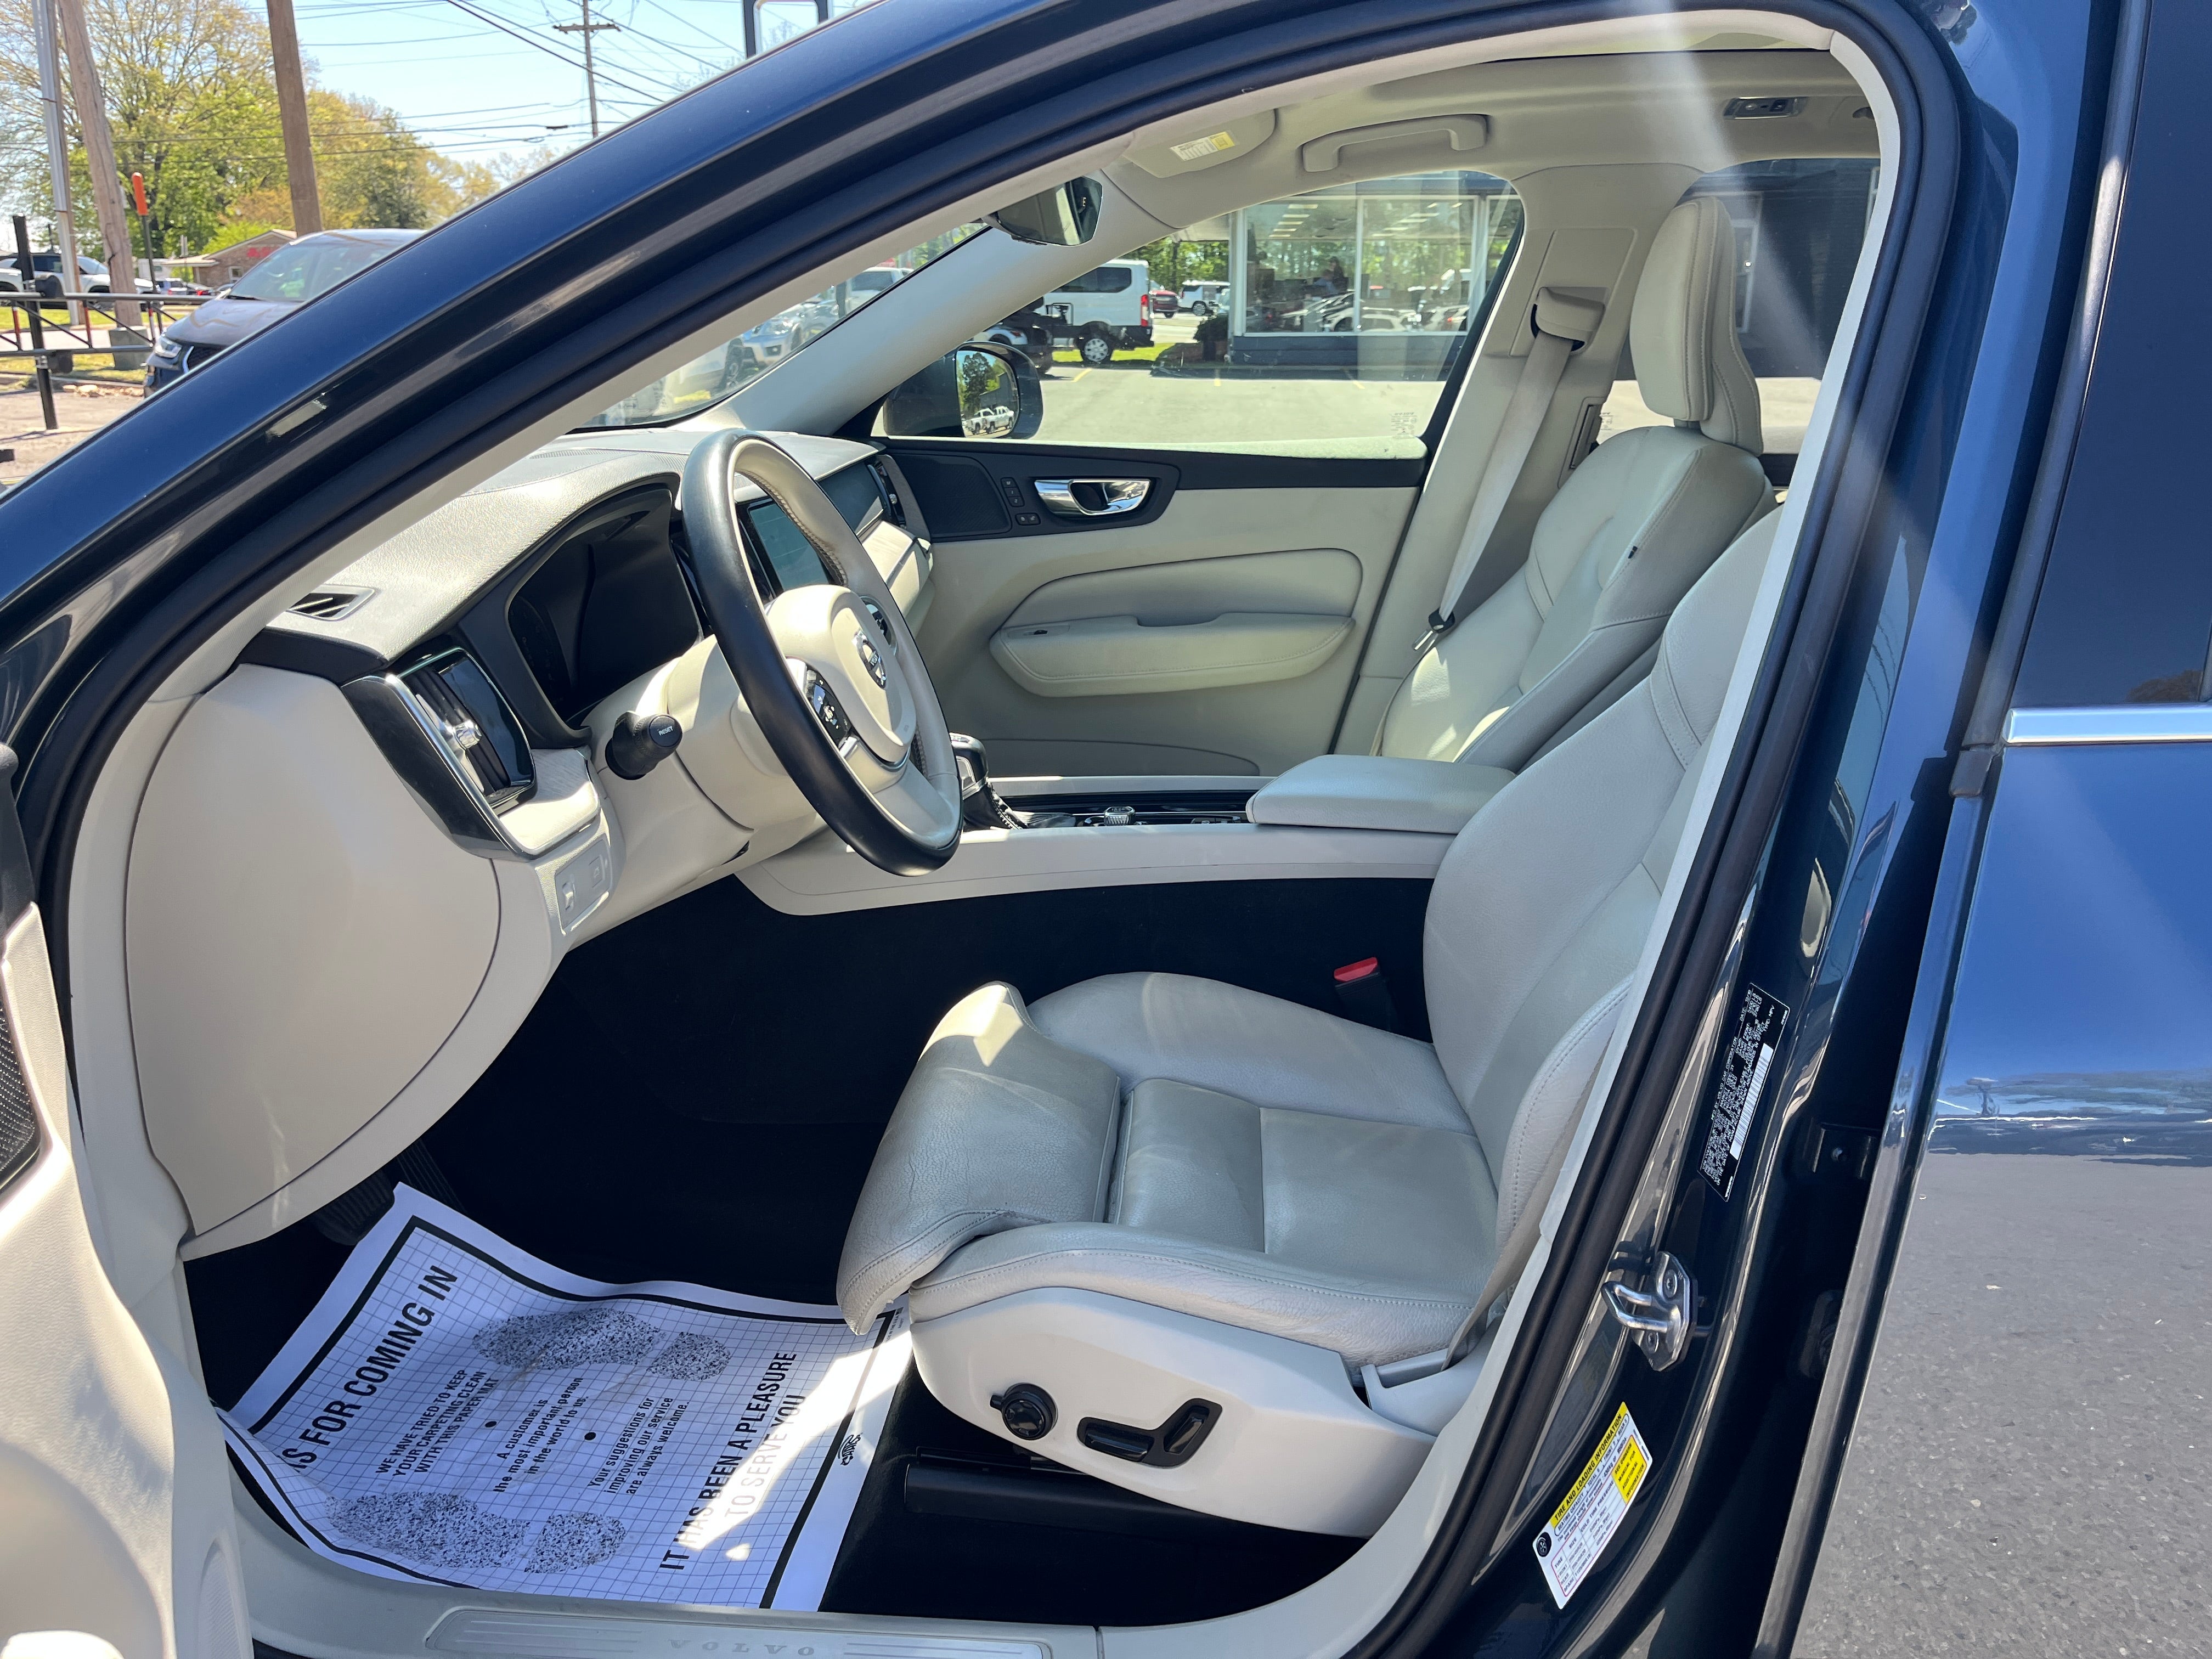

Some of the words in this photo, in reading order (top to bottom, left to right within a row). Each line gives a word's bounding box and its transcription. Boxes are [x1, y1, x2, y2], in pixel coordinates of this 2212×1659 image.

[658, 726, 673, 736] RESET
[298, 1400, 362, 1446] FOR
[344, 1302, 435, 1396] COMING
[417, 1265, 458, 1301] IN
[735, 1352, 797, 1434] PLEASURE
[375, 1458, 397, 1474] WE
[390, 1433, 418, 1455] HAVE
[410, 1406, 439, 1431] TRIED
[433, 1392, 451, 1403] TO
[444, 1369, 468, 1390] KEEP
[392, 1449, 423, 1476] YOUR
[416, 1400, 464, 1447] CARPETING
[457, 1372, 487, 1398] CLEAN
[414, 1446, 443, 1472] WITH
[435, 1425, 460, 1444] THIS
[454, 1396, 484, 1422] PAPER
[493, 1476, 512, 1492] the
[507, 1449, 531, 1474] most
[523, 1406, 562, 1447] important
[557, 1378, 584, 1404] person
[505, 1408, 540, 1449] customer
[524, 1465, 540, 1474] in
[533, 1448, 551, 1463] the
[546, 1419, 570, 1446] world
[563, 1409, 578, 1418] to
[573, 1396, 589, 1407] us.
[588, 1468, 611, 1487] Your
[606, 1412, 646, 1466] suggestions
[638, 1397, 654, 1410] for
[603, 1448, 645, 1493] improving
[637, 1430, 653, 1446] our
[647, 1398, 673, 1428] service
[626, 1480, 642, 1494] are
[637, 1444, 663, 1477] always
[657, 1401, 690, 1443] welcome.
[724, 1494, 757, 1518] TO
[741, 1433, 788, 1487] SERVE
[771, 1394, 806, 1427] YOU
[727, 1439, 752, 1451] A
[698, 1455, 743, 1499] BEEN
[1554, 1503, 1566, 1522] TIRE
[1565, 1488, 1576, 1506] AND
[1575, 1459, 1595, 1491] LOADING
[1594, 1412, 1622, 1462] INFORMATION
[1569, 1491, 1584, 1514] CAPACITY
[659, 1549, 690, 1570] IT
[673, 1506, 715, 1544] HAS
[668, 1638, 815, 1656] VOLVO
